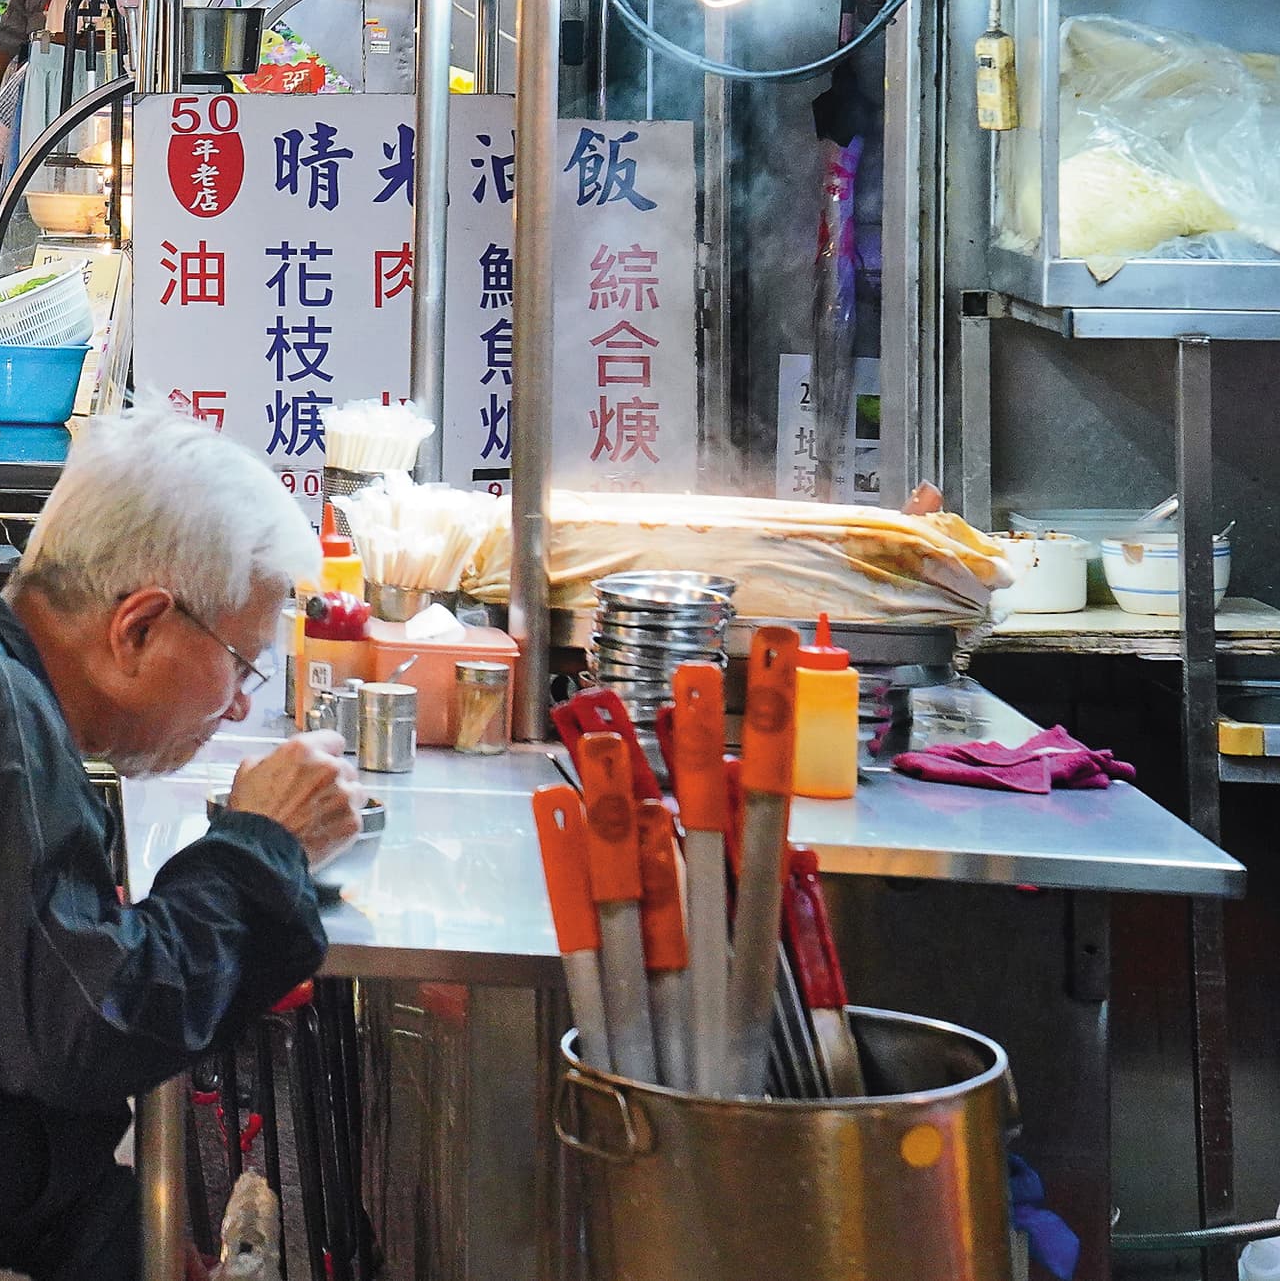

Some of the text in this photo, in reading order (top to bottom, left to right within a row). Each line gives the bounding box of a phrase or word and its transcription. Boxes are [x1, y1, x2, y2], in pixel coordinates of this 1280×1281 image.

[170, 95, 240, 213] 50 年老店
